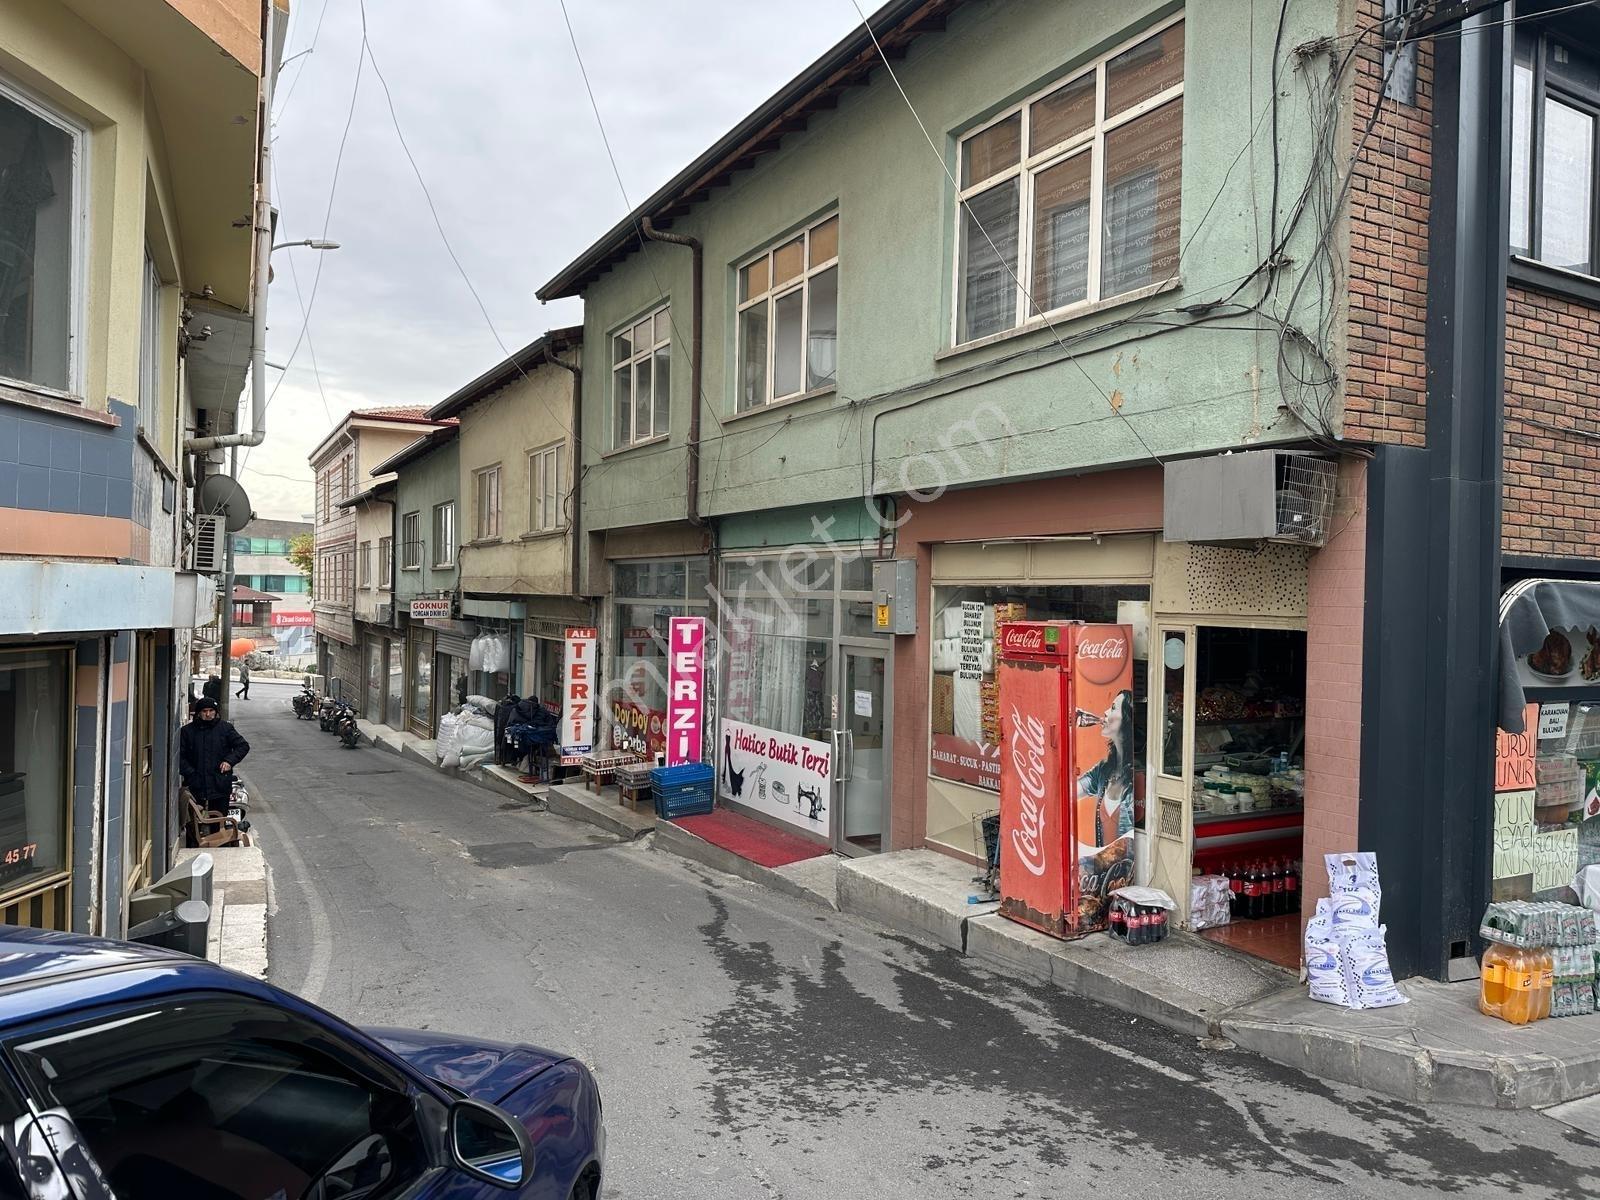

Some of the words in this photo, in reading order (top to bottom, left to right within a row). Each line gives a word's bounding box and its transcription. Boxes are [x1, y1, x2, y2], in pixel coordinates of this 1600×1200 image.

[615, 704, 630, 729] Doy
[632, 708, 648, 735] Doy
[734, 728, 766, 756] Hatice
[768, 738, 798, 766] Butik
[801, 746, 830, 778] Terzi
[932, 749, 957, 764] BAHARAT
[960, 756, 978, 769] SUCUK
[1495, 759, 1534, 787] UNUR
[1494, 794, 1534, 825] YUN
[5, 849, 20, 864] 45
[23, 843, 37, 860] 77
[1494, 846, 1533, 879] UNUR
